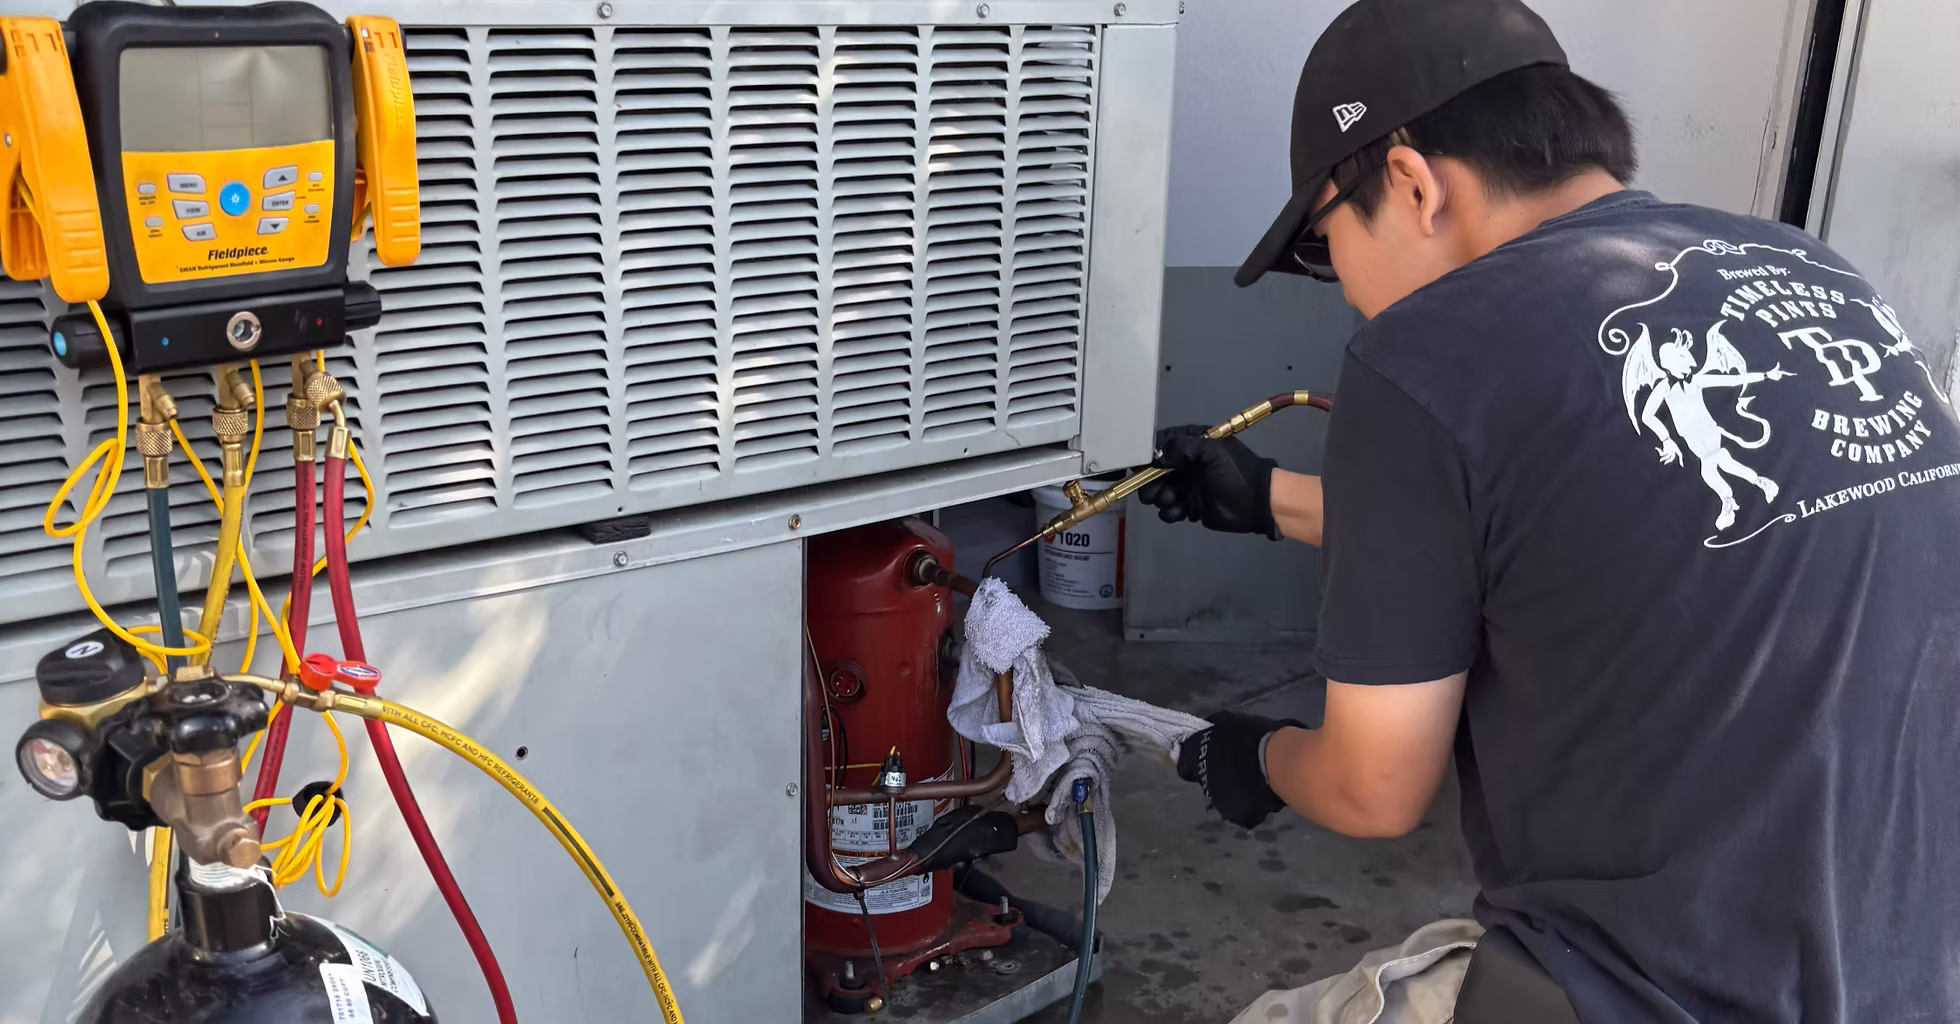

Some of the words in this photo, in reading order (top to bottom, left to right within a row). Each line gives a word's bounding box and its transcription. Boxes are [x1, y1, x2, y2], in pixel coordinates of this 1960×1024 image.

[207, 246, 269, 260] Fieldpiece
[1717, 265, 1769, 280] Brewed
[1720, 280, 1845, 321] TIMELESS
[1755, 300, 1837, 328] PINTS
[1811, 390, 1923, 437] BREWING
[1830, 419, 1932, 464] COMPANY
[1797, 477, 1896, 518] LAKEWOOD
[1060, 531, 1090, 548] 1020
[402, 713, 419, 725] ALL
[441, 730, 462, 746] HCFC
[462, 743, 479, 756] AND
[479, 753, 494, 766] HFC
[493, 762, 540, 805] REFRIGERANTS
[653, 971, 662, 983] ALL
